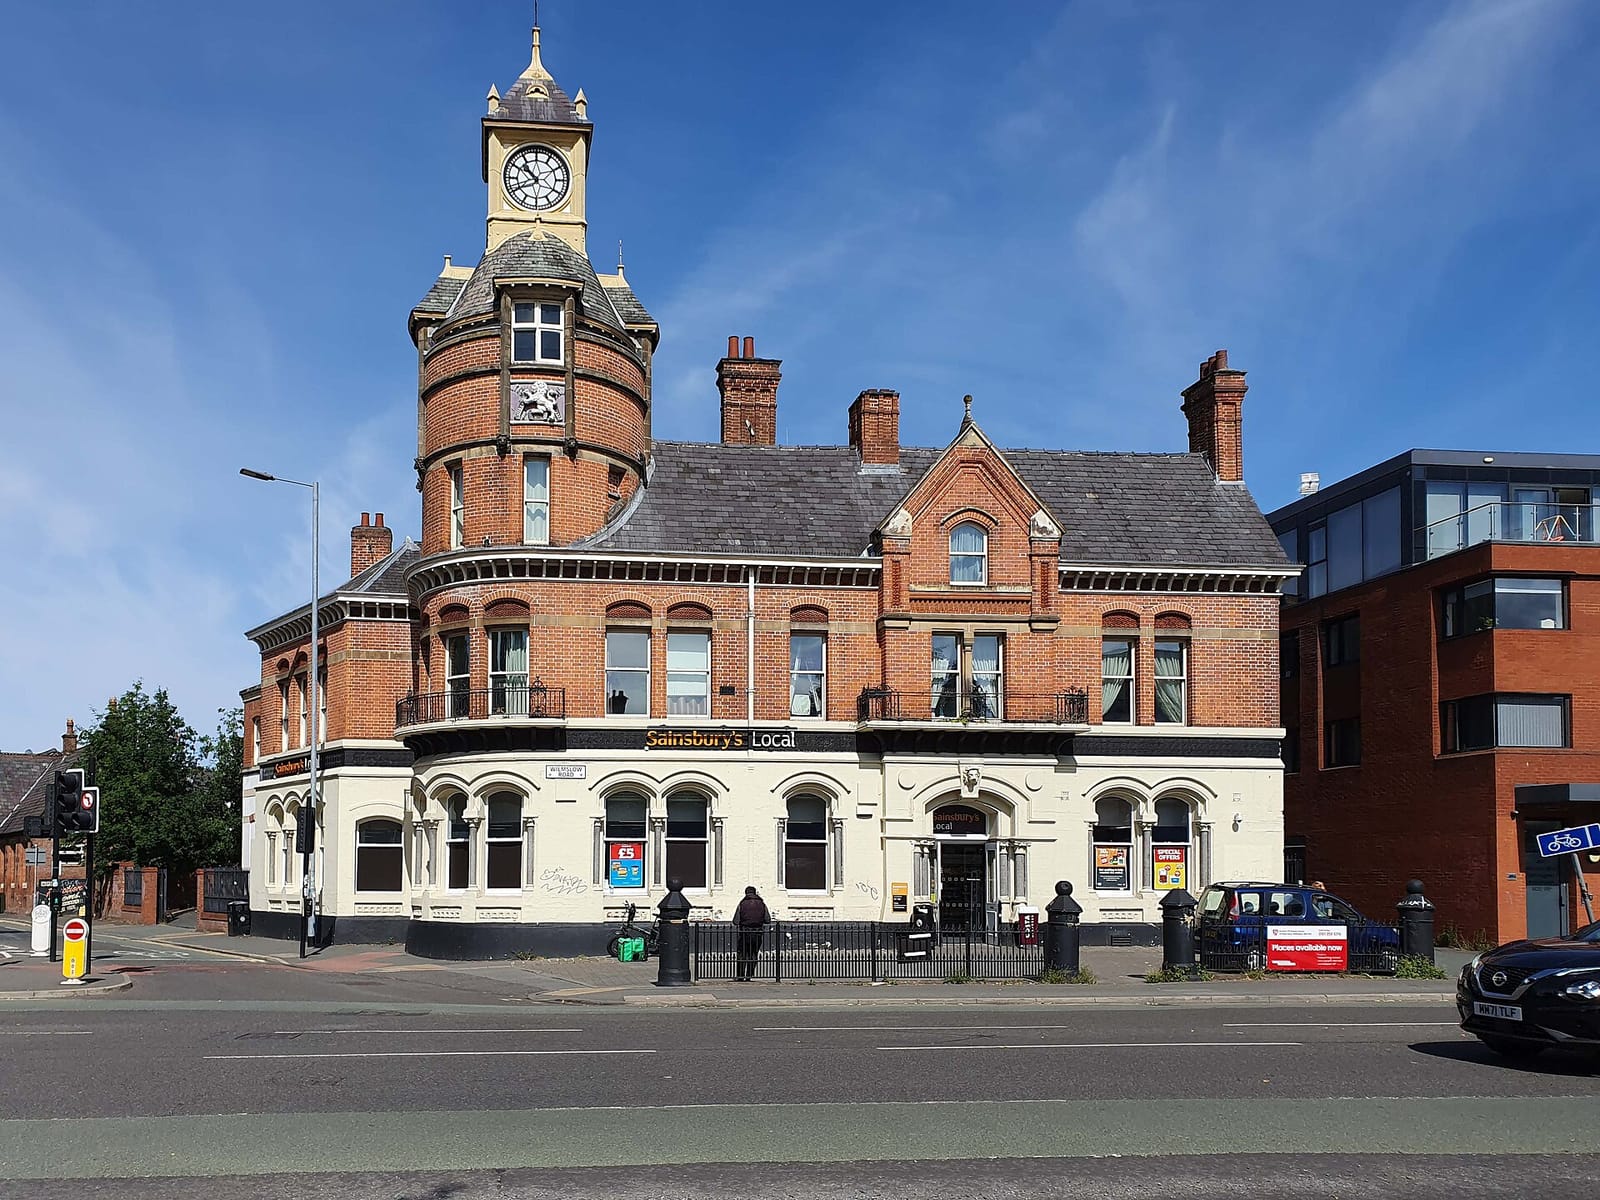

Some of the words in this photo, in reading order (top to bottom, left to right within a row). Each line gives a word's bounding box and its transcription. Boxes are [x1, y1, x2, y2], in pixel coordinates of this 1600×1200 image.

[646, 730, 743, 749] Sainsbury's
[752, 731, 796, 747] Local
[618, 847, 635, 859] £5
[1271, 943, 1294, 951] Places
[1295, 943, 1327, 951] available
